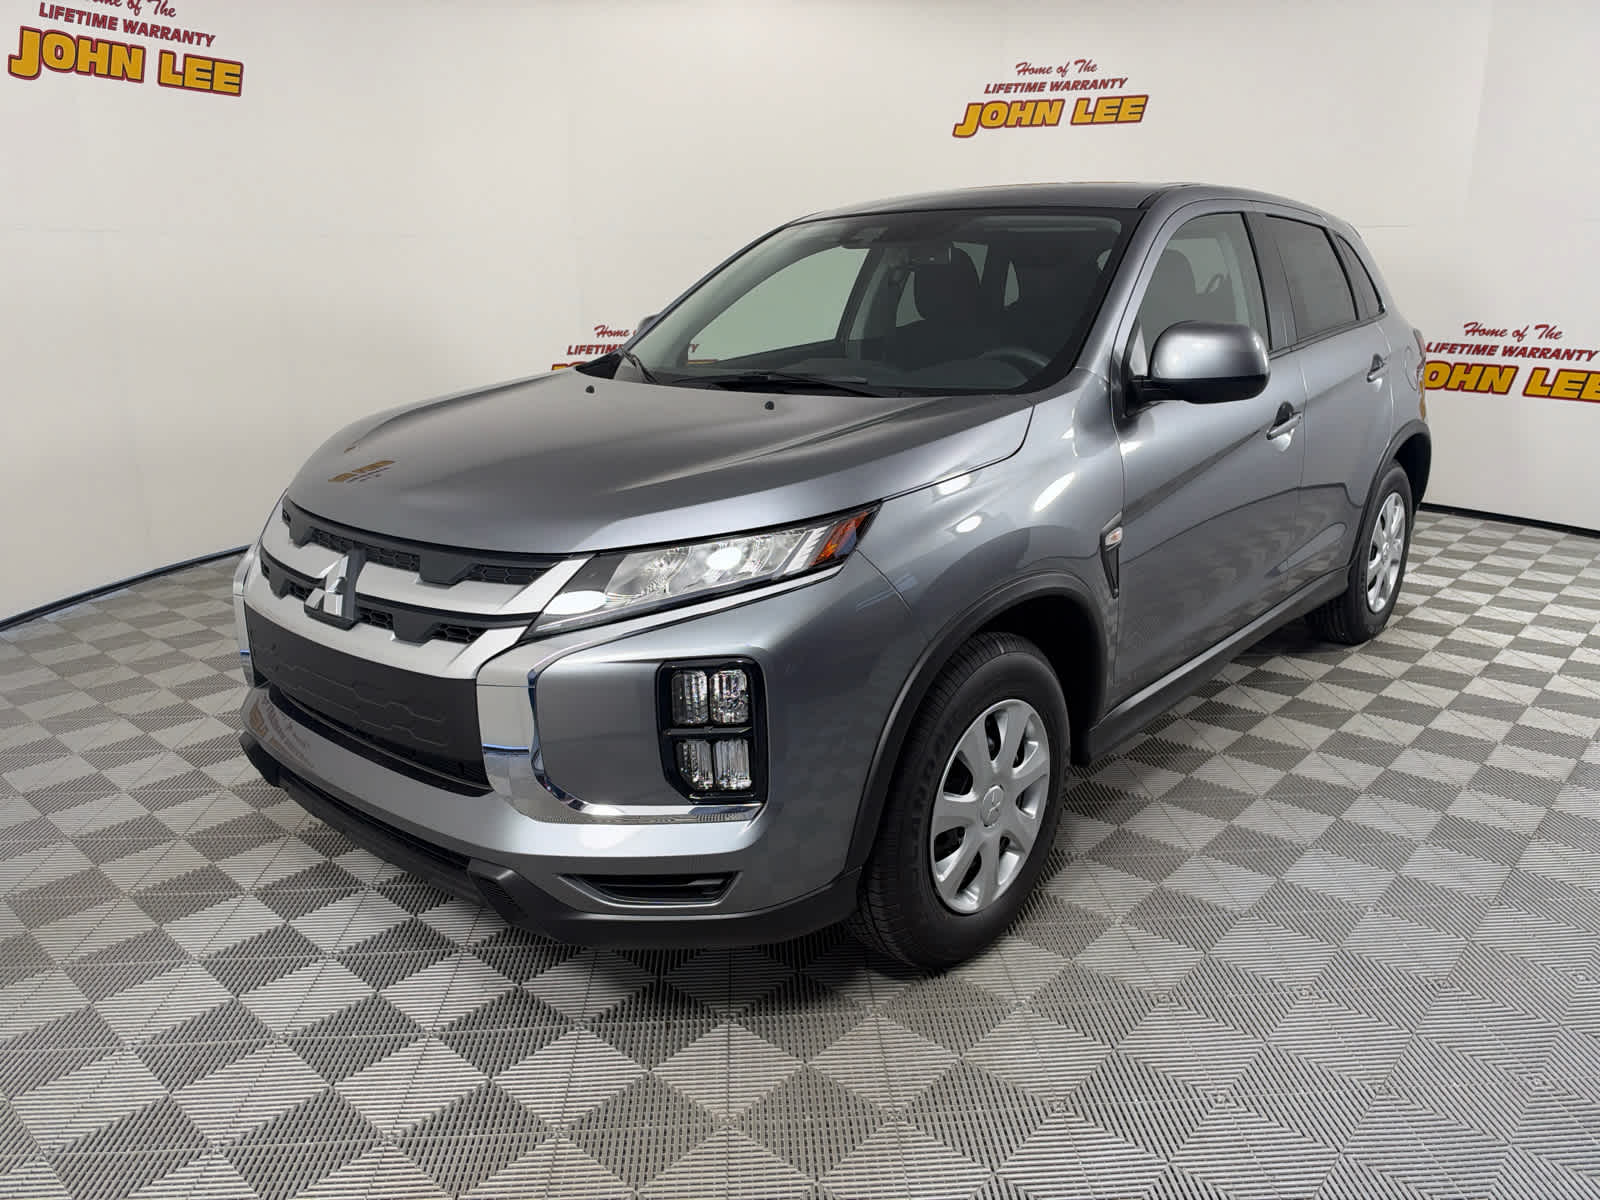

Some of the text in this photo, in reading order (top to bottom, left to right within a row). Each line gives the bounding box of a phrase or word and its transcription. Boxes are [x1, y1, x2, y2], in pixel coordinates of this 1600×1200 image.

[147, 0, 176, 18] The
[39, 2, 216, 47] LIFETIME WARRANTY
[8, 26, 244, 97] JOHN LEE
[1015, 59, 1098, 78] Home of The
[984, 77, 1128, 95] LIFETIME WARRANTY
[952, 94, 1149, 139] JOHN LEE
[593, 324, 630, 338] Home
[1464, 321, 1563, 342] Home of The
[1425, 341, 1599, 362] LIFETIME WARRANTY
[1425, 359, 1519, 395] OHN
